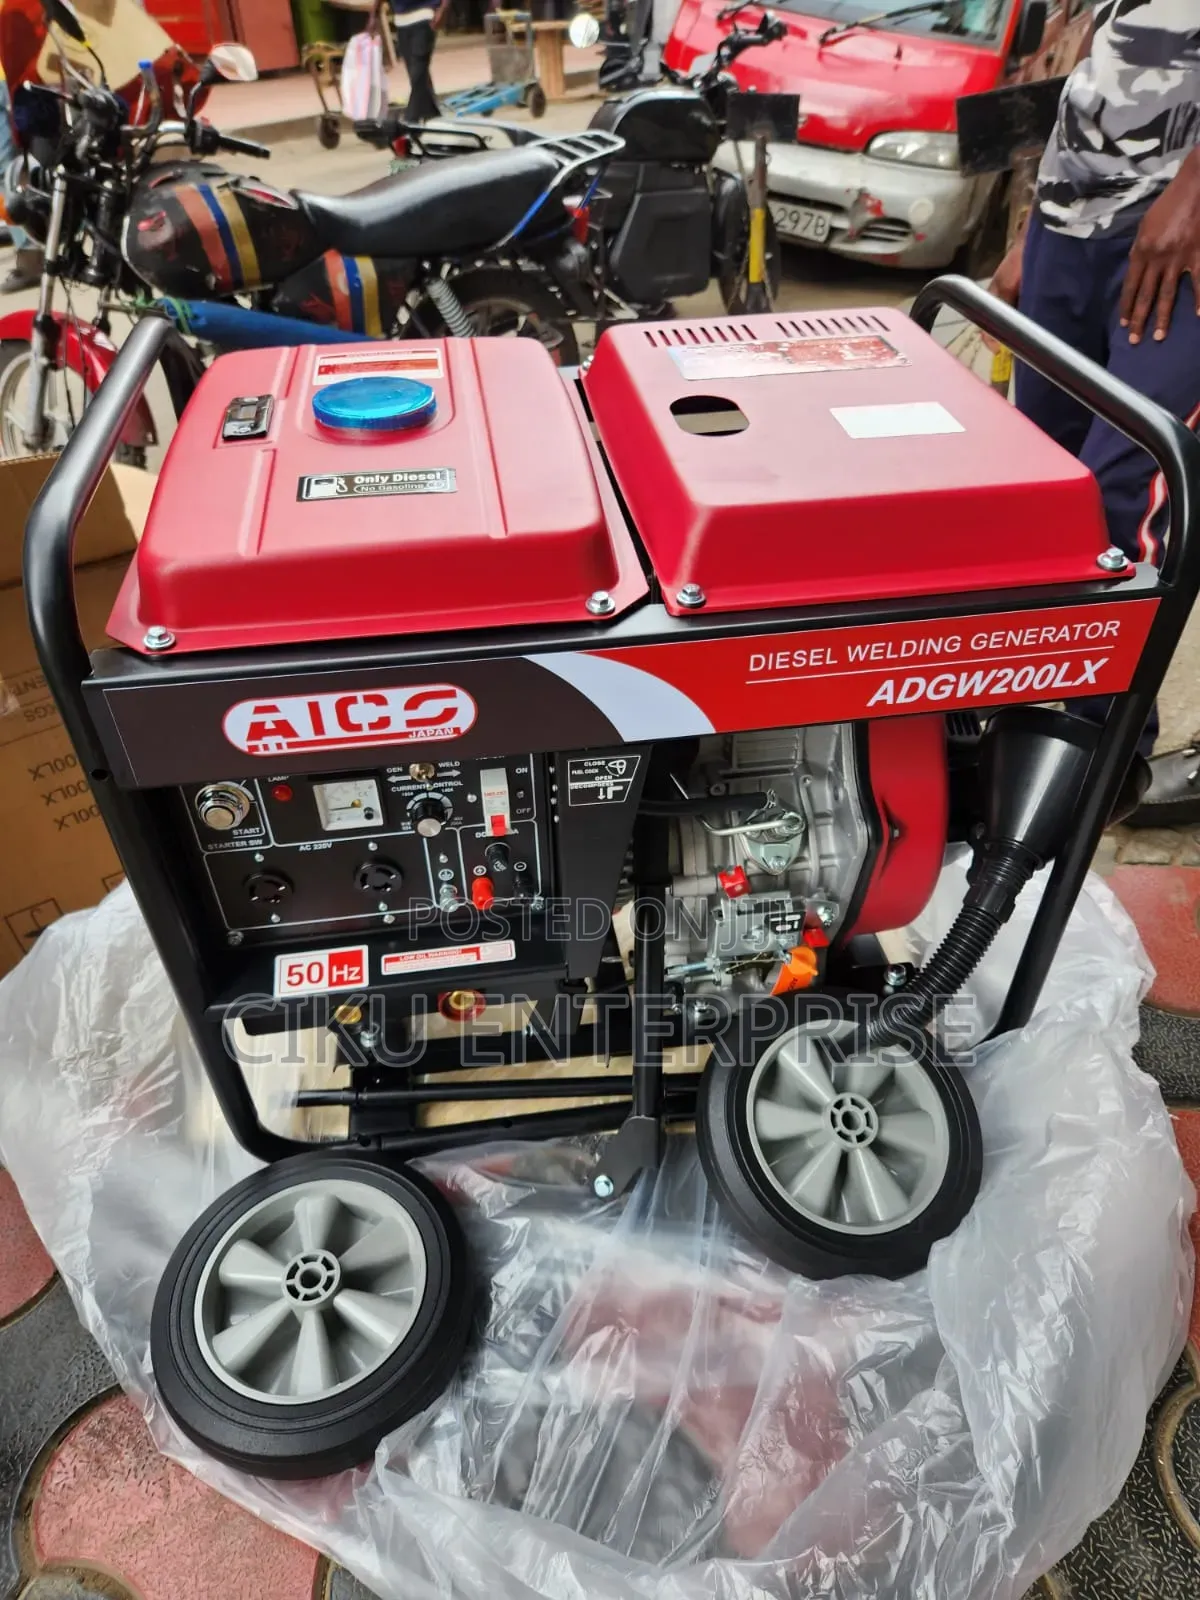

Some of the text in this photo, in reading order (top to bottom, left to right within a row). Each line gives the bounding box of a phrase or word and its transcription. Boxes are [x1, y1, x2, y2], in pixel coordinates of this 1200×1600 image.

[354, 471, 441, 484] Only Diesel
[748, 619, 1121, 672] DIESEL WELDING GENERATOR
[866, 657, 1109, 708] ADGW200LX
[408, 726, 454, 739] JAPAN
[386, 766, 403, 774] GEN
[438, 760, 461, 768] WELD
[391, 780, 464, 793] CURRENT ONTROL
[515, 807, 532, 815] OFF
[232, 827, 261, 836] START
[208, 838, 263, 850] STARTER SW
[299, 844, 312, 852] AC
[399, 954, 415, 962] LOW
[286, 961, 324, 986] 50
[331, 963, 361, 983] Hz
